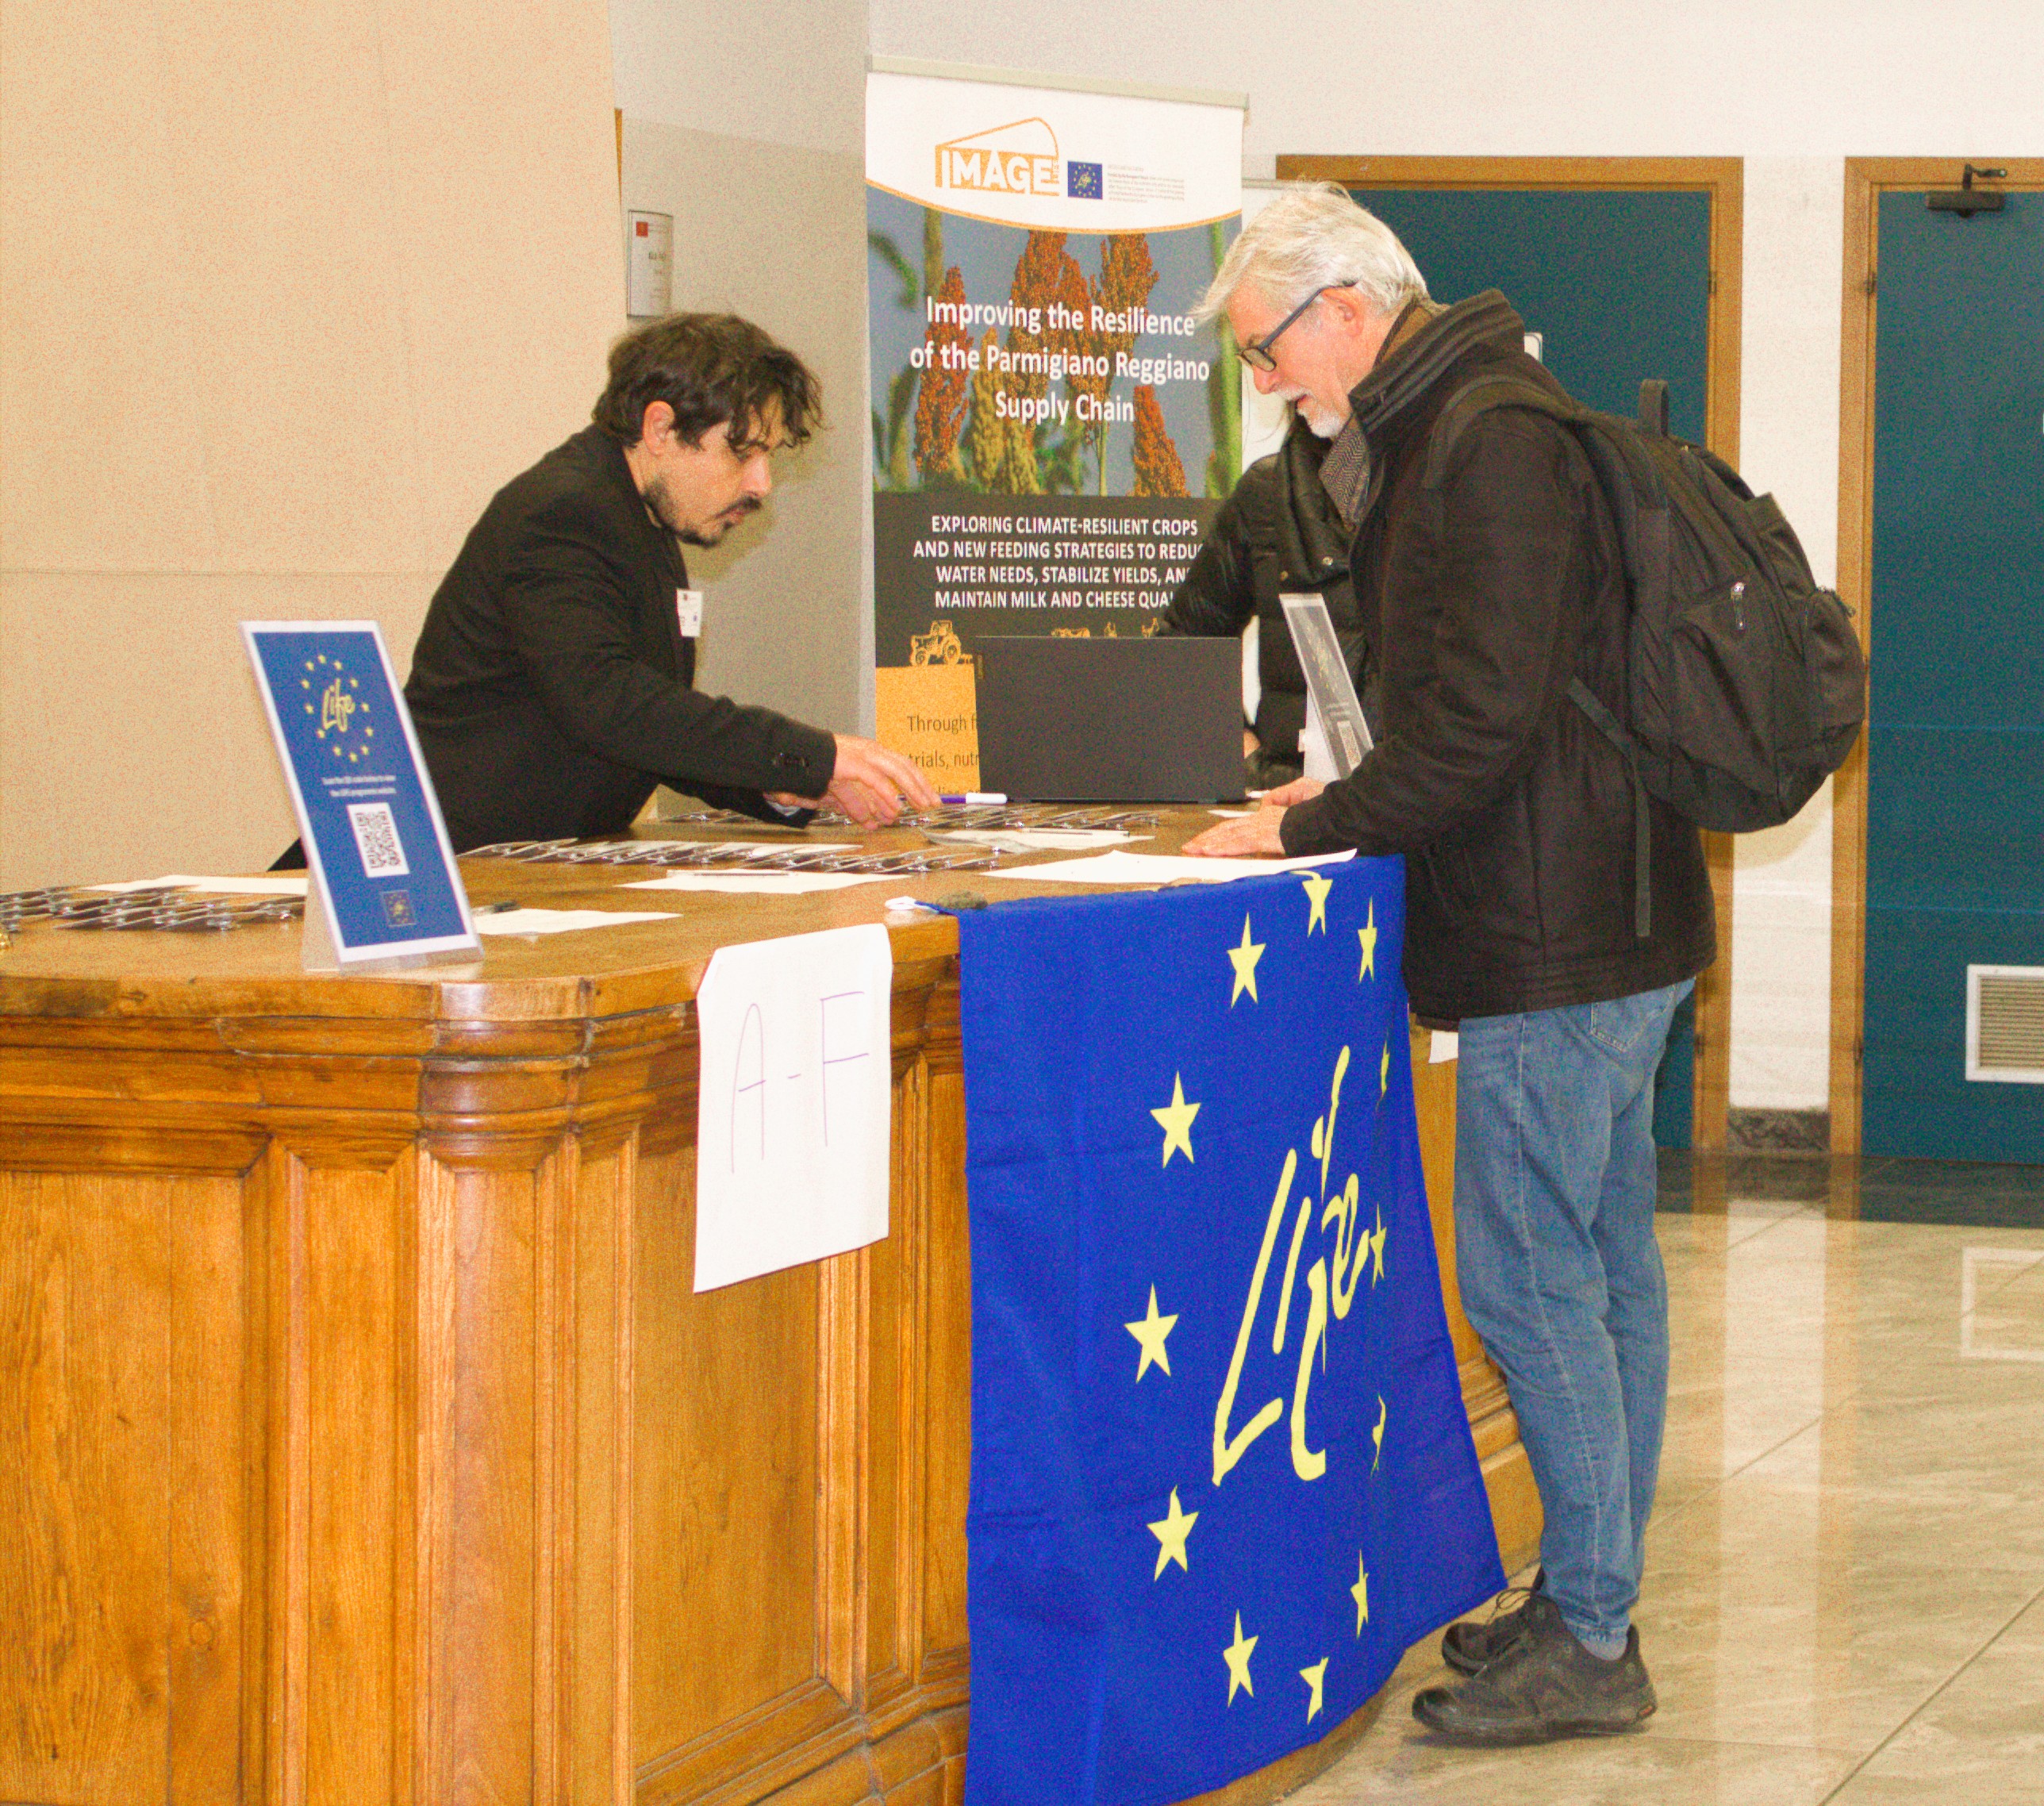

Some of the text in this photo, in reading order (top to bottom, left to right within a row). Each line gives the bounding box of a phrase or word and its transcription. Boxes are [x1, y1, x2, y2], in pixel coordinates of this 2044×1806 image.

[941, 150, 1053, 193] IMAGE
[927, 295, 1196, 336] Improving the Resilience
[910, 340, 1210, 385] of the Parmigiano Reggiano
[995, 390, 1135, 425] Supply Chain
[932, 515, 1198, 536] EXPLORING CLIMATE-RESILIENT CROPS
[913, 540, 949, 558] AND
[954, 541, 986, 558] NEW
[990, 541, 1050, 559] FEEDING
[1055, 542, 1135, 559] STRATEGIES
[1137, 543, 1156, 559] TO
[936, 566, 1189, 586] WATER NEEDS, STABILIZE YIELDS, AN
[936, 590, 1007, 608] MAINTAIN
[1012, 590, 1047, 608] MILK
[1051, 590, 1082, 608] AND
[1085, 590, 1135, 608] CHEESE
[907, 715, 966, 735] Through
